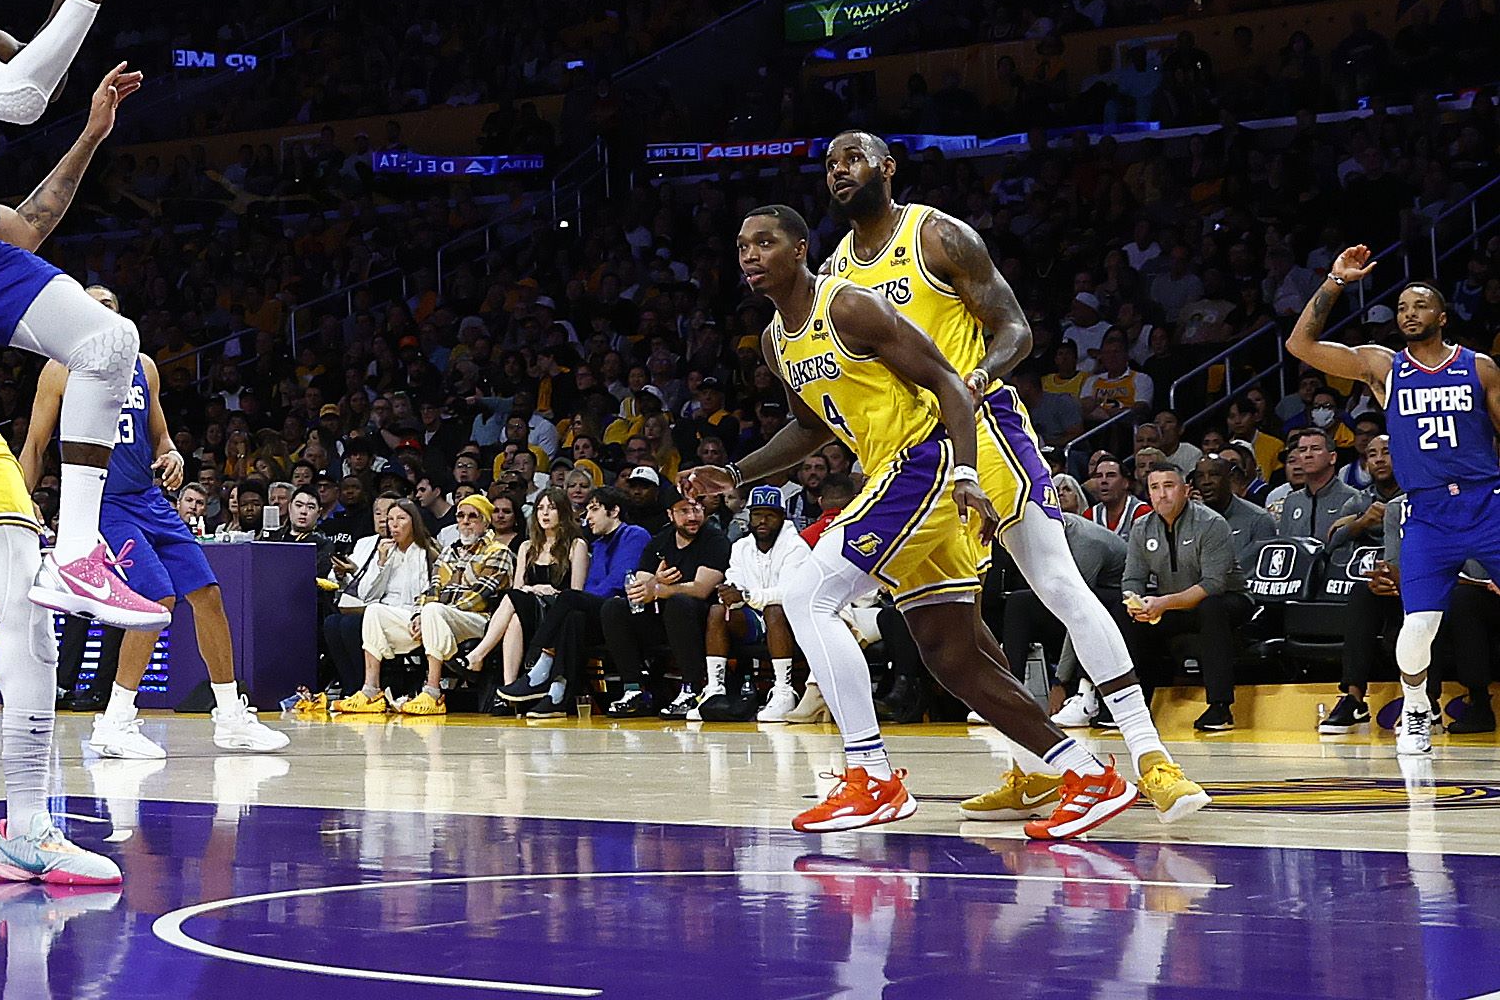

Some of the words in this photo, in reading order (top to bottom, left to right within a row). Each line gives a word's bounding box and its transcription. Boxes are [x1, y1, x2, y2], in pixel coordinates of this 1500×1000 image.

[786, 352, 841, 392] LAKERS
[822, 394, 856, 438] 4
[1398, 384, 1473, 416] CLIPPERS
[1417, 415, 1458, 450] 24
